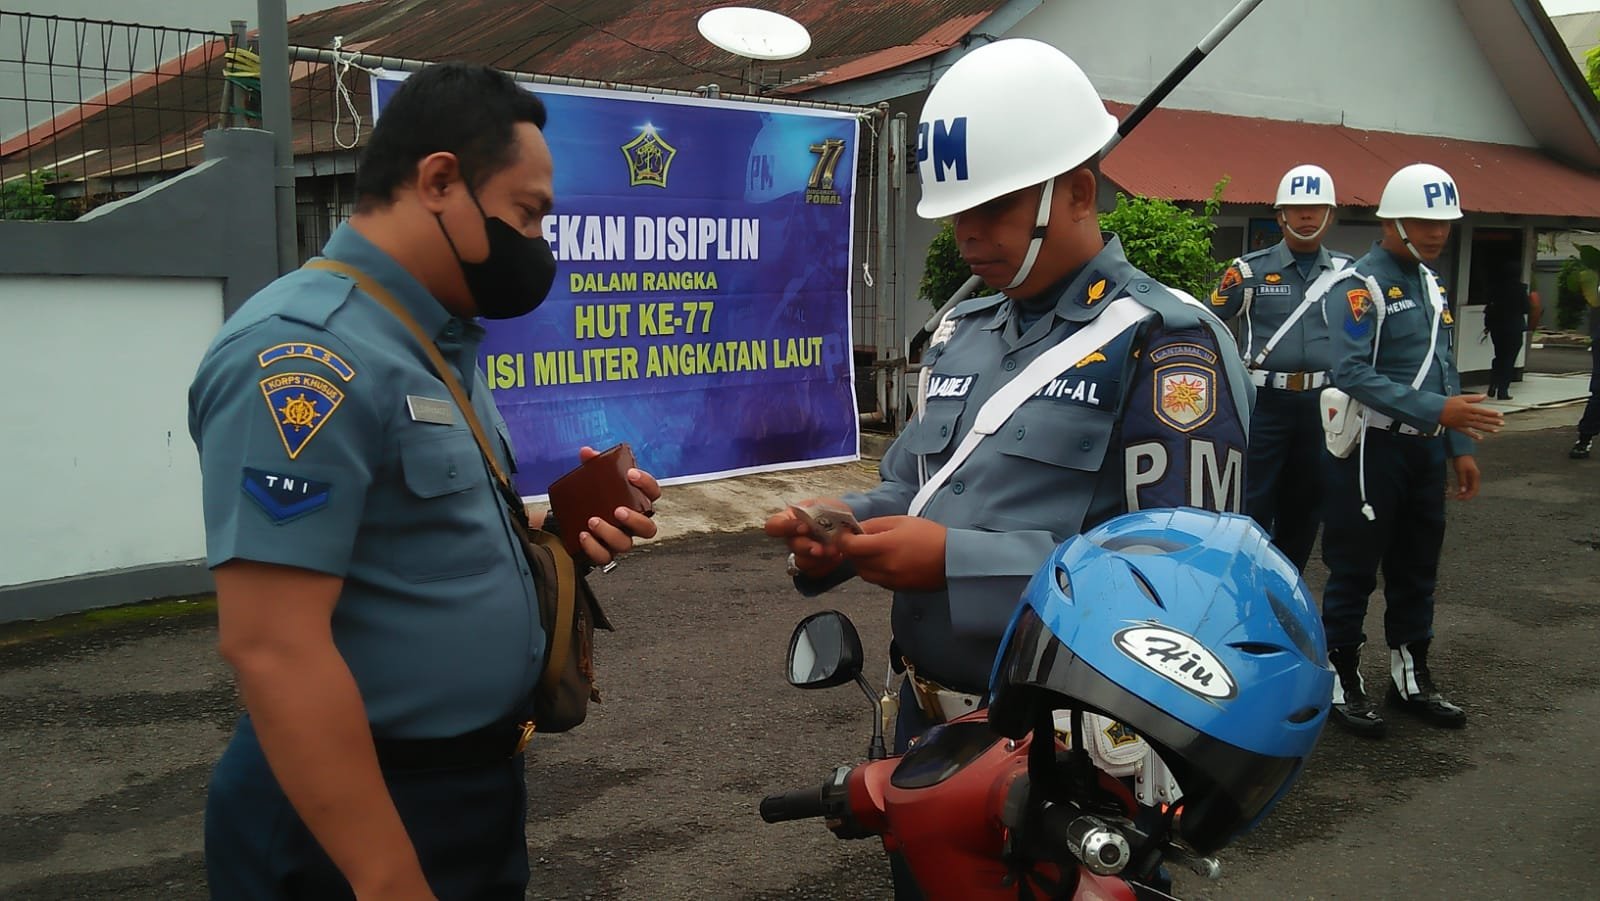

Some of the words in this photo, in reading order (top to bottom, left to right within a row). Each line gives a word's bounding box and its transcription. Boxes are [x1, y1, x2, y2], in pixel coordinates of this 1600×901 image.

[917, 116, 969, 185] PM
[750, 155, 775, 192] PM
[1290, 175, 1321, 195] PM
[805, 195, 842, 205] POMAL
[1423, 181, 1457, 208] PM
[634, 216, 760, 261] DISIPLIN
[570, 272, 637, 293] DALAM
[642, 271, 718, 291] RANGKA
[575, 303, 632, 340] HUT
[638, 301, 715, 336] KE-77
[534, 346, 640, 387] MILITER
[645, 340, 768, 378] ANGKATAN
[773, 336, 824, 370] LAUT
[268, 376, 302, 391] KORPS
[303, 376, 338, 401] KHUSUS
[266, 475, 308, 494] TNI
[1125, 438, 1242, 513] PM
[1145, 636, 1215, 688] Hiu
